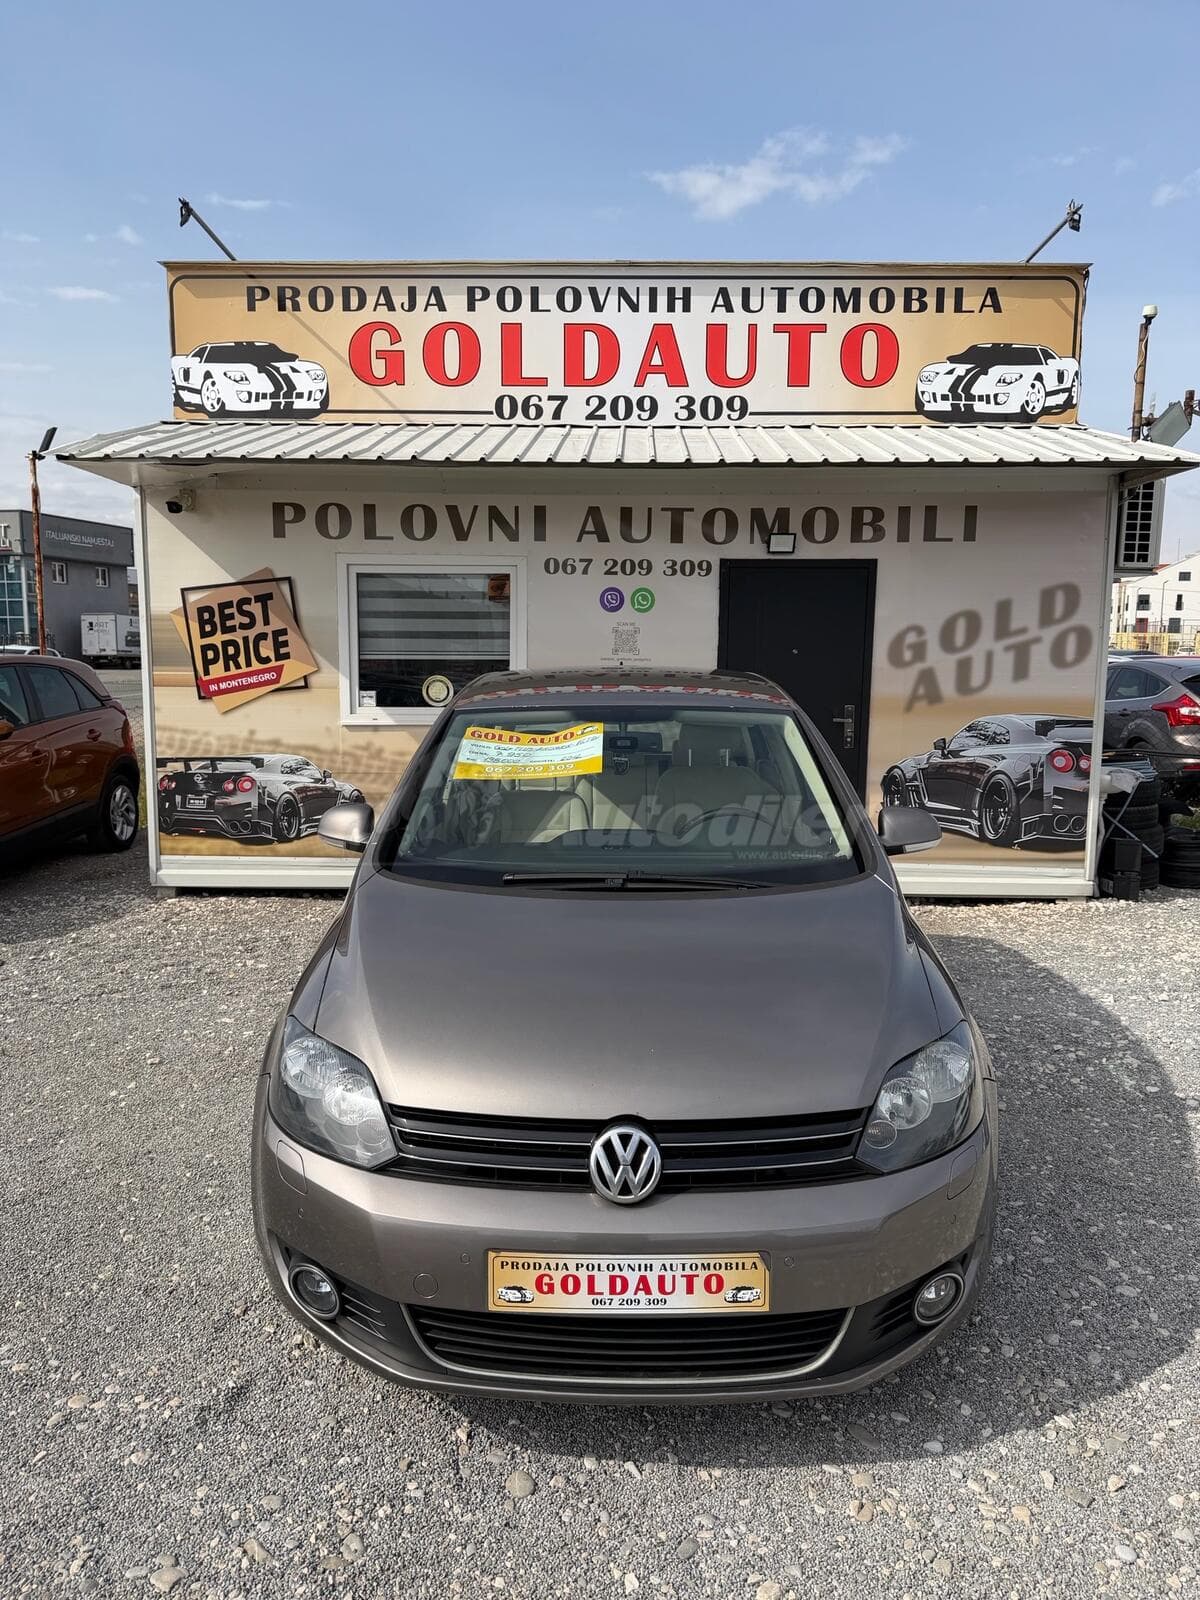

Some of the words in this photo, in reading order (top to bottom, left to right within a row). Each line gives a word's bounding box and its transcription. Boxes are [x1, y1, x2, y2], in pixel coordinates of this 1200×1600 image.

[246, 285, 448, 313] PRODAJA
[466, 285, 692, 313] POLOVNIH
[710, 286, 1003, 314] AUTOMOBILA
[348, 320, 900, 389] GOLDAUTO
[494, 394, 569, 421] 067
[585, 394, 659, 422] 209
[674, 394, 749, 422] 309
[272, 501, 547, 543] POLOVNI
[576, 505, 979, 545] AUTOMOBILI
[544, 557, 594, 576] 067
[603, 557, 653, 576] 209
[663, 558, 713, 577] 309
[197, 592, 274, 639] BEST
[887, 581, 1082, 669] GOLD
[200, 628, 291, 677] PRICE
[209, 684, 218, 692] IN
[219, 671, 277, 691] MONTENEGRO
[904, 623, 1093, 714] AUTO
[470, 730, 521, 743] GOLD
[527, 731, 575, 744] AUTO
[517, 765, 544, 773] 209
[547, 763, 575, 771] 309
[500, 1260, 570, 1272] PRODAJA
[575, 1262, 654, 1273] POLOVNIH
[659, 1260, 759, 1272] AUTOMOBILA
[534, 1273, 725, 1296] GOLDAUTO
[591, 1297, 616, 1306] 067
[618, 1297, 641, 1306] 209
[644, 1297, 667, 1306] 309
